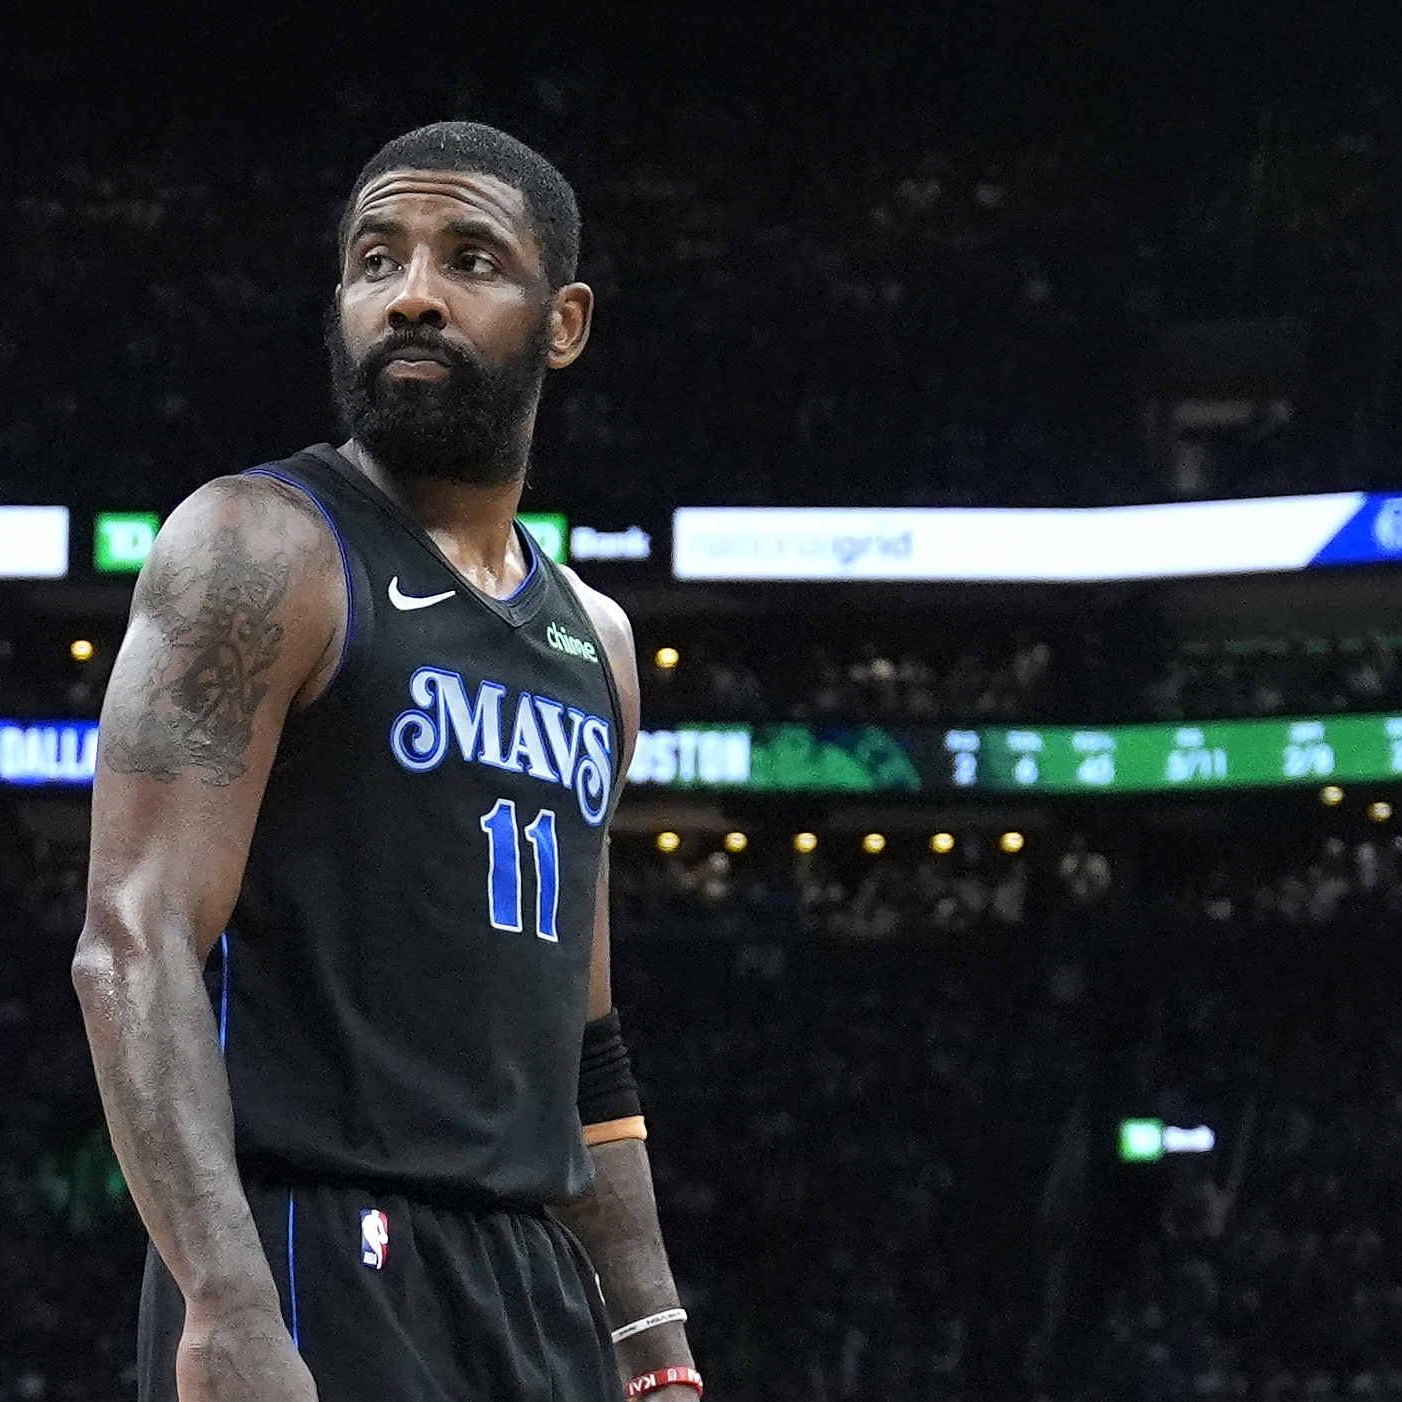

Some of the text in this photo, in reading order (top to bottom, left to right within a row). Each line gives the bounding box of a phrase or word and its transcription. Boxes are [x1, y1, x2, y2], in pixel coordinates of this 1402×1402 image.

[547, 621, 599, 663] chime
[390, 665, 612, 826] MAVS
[628, 730, 750, 782] OSTON
[480, 798, 558, 943] 11
